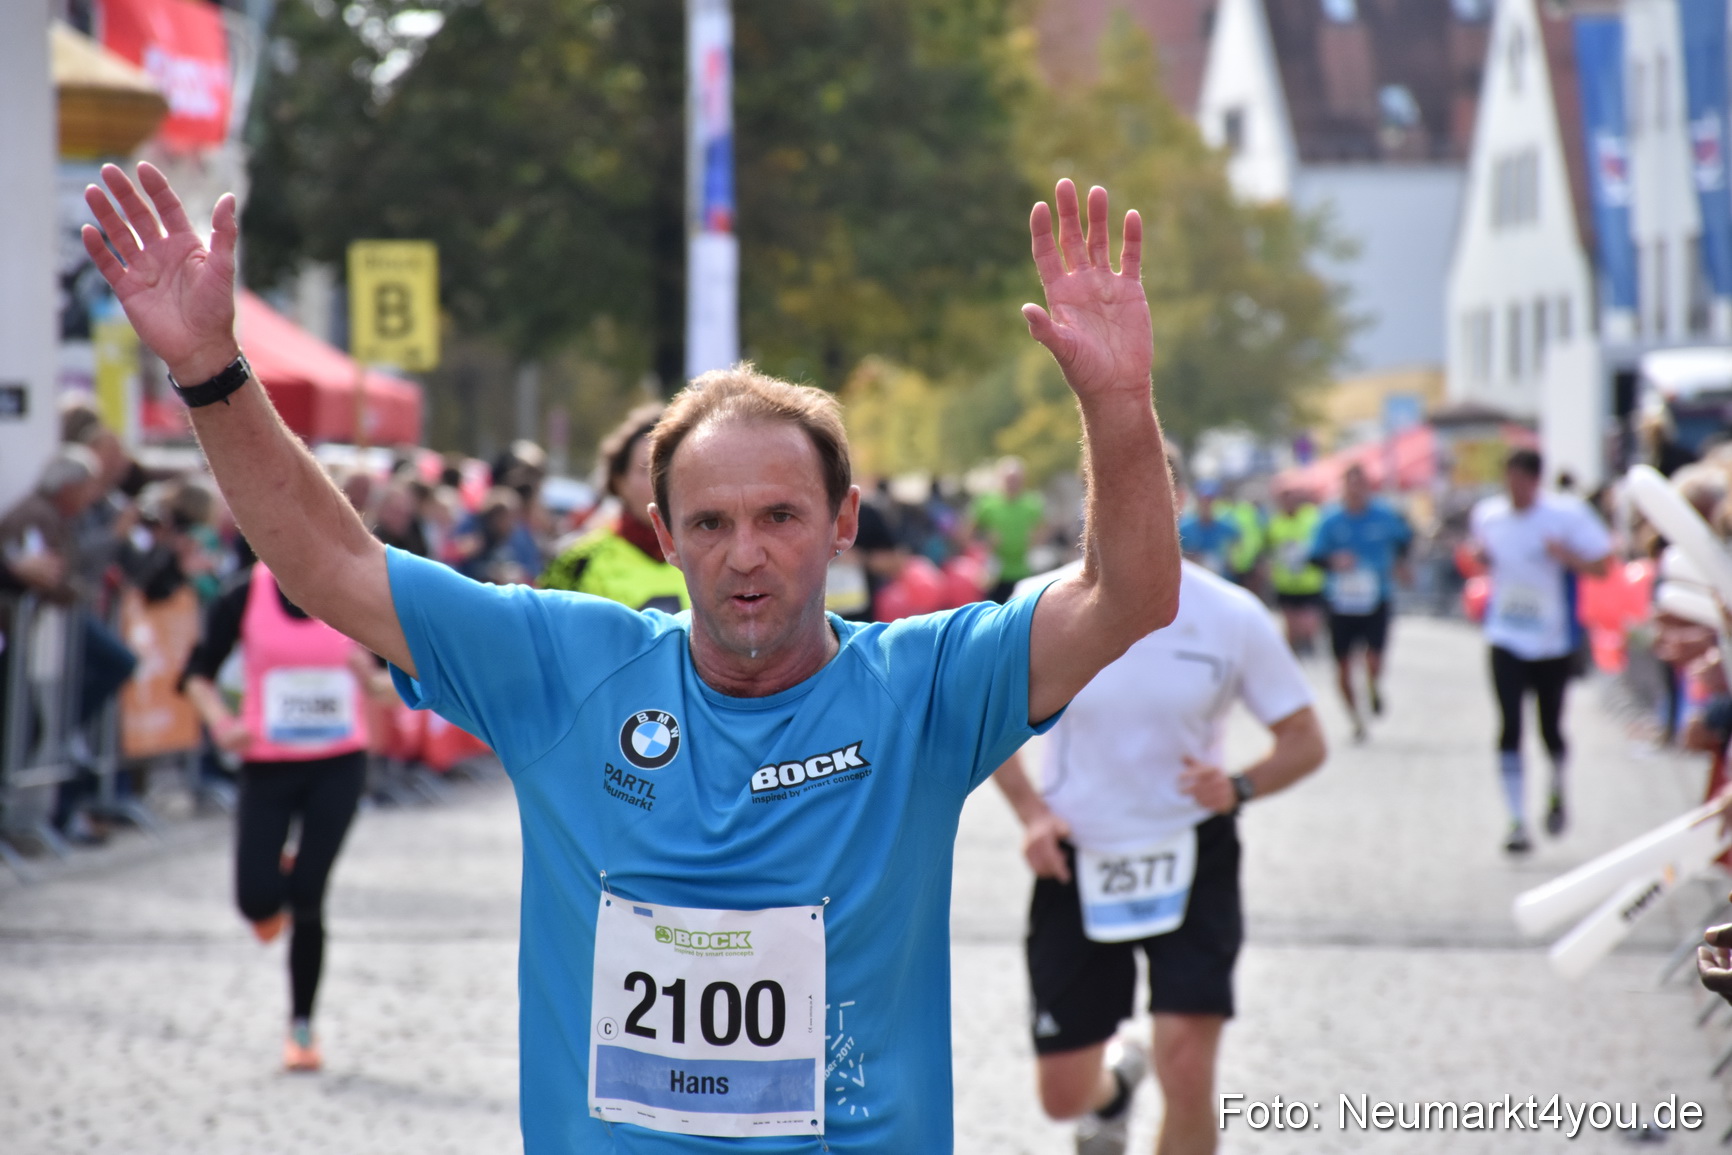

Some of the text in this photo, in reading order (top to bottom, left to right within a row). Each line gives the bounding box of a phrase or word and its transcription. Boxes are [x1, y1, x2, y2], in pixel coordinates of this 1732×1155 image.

[375, 281, 414, 340] B
[636, 712, 679, 738] BMW
[604, 762, 656, 800] PARTL
[751, 744, 865, 791] BOCK
[603, 779, 654, 812] Neumarkt
[752, 769, 872, 804] inspired by smart concepts
[1099, 852, 1176, 895] 2577
[674, 928, 752, 950] BOCK
[674, 947, 695, 956] inspired
[624, 971, 786, 1047] 2100
[604, 1023, 612, 1035] C
[836, 1036, 855, 1063] 2017
[669, 1070, 730, 1095] Hans
